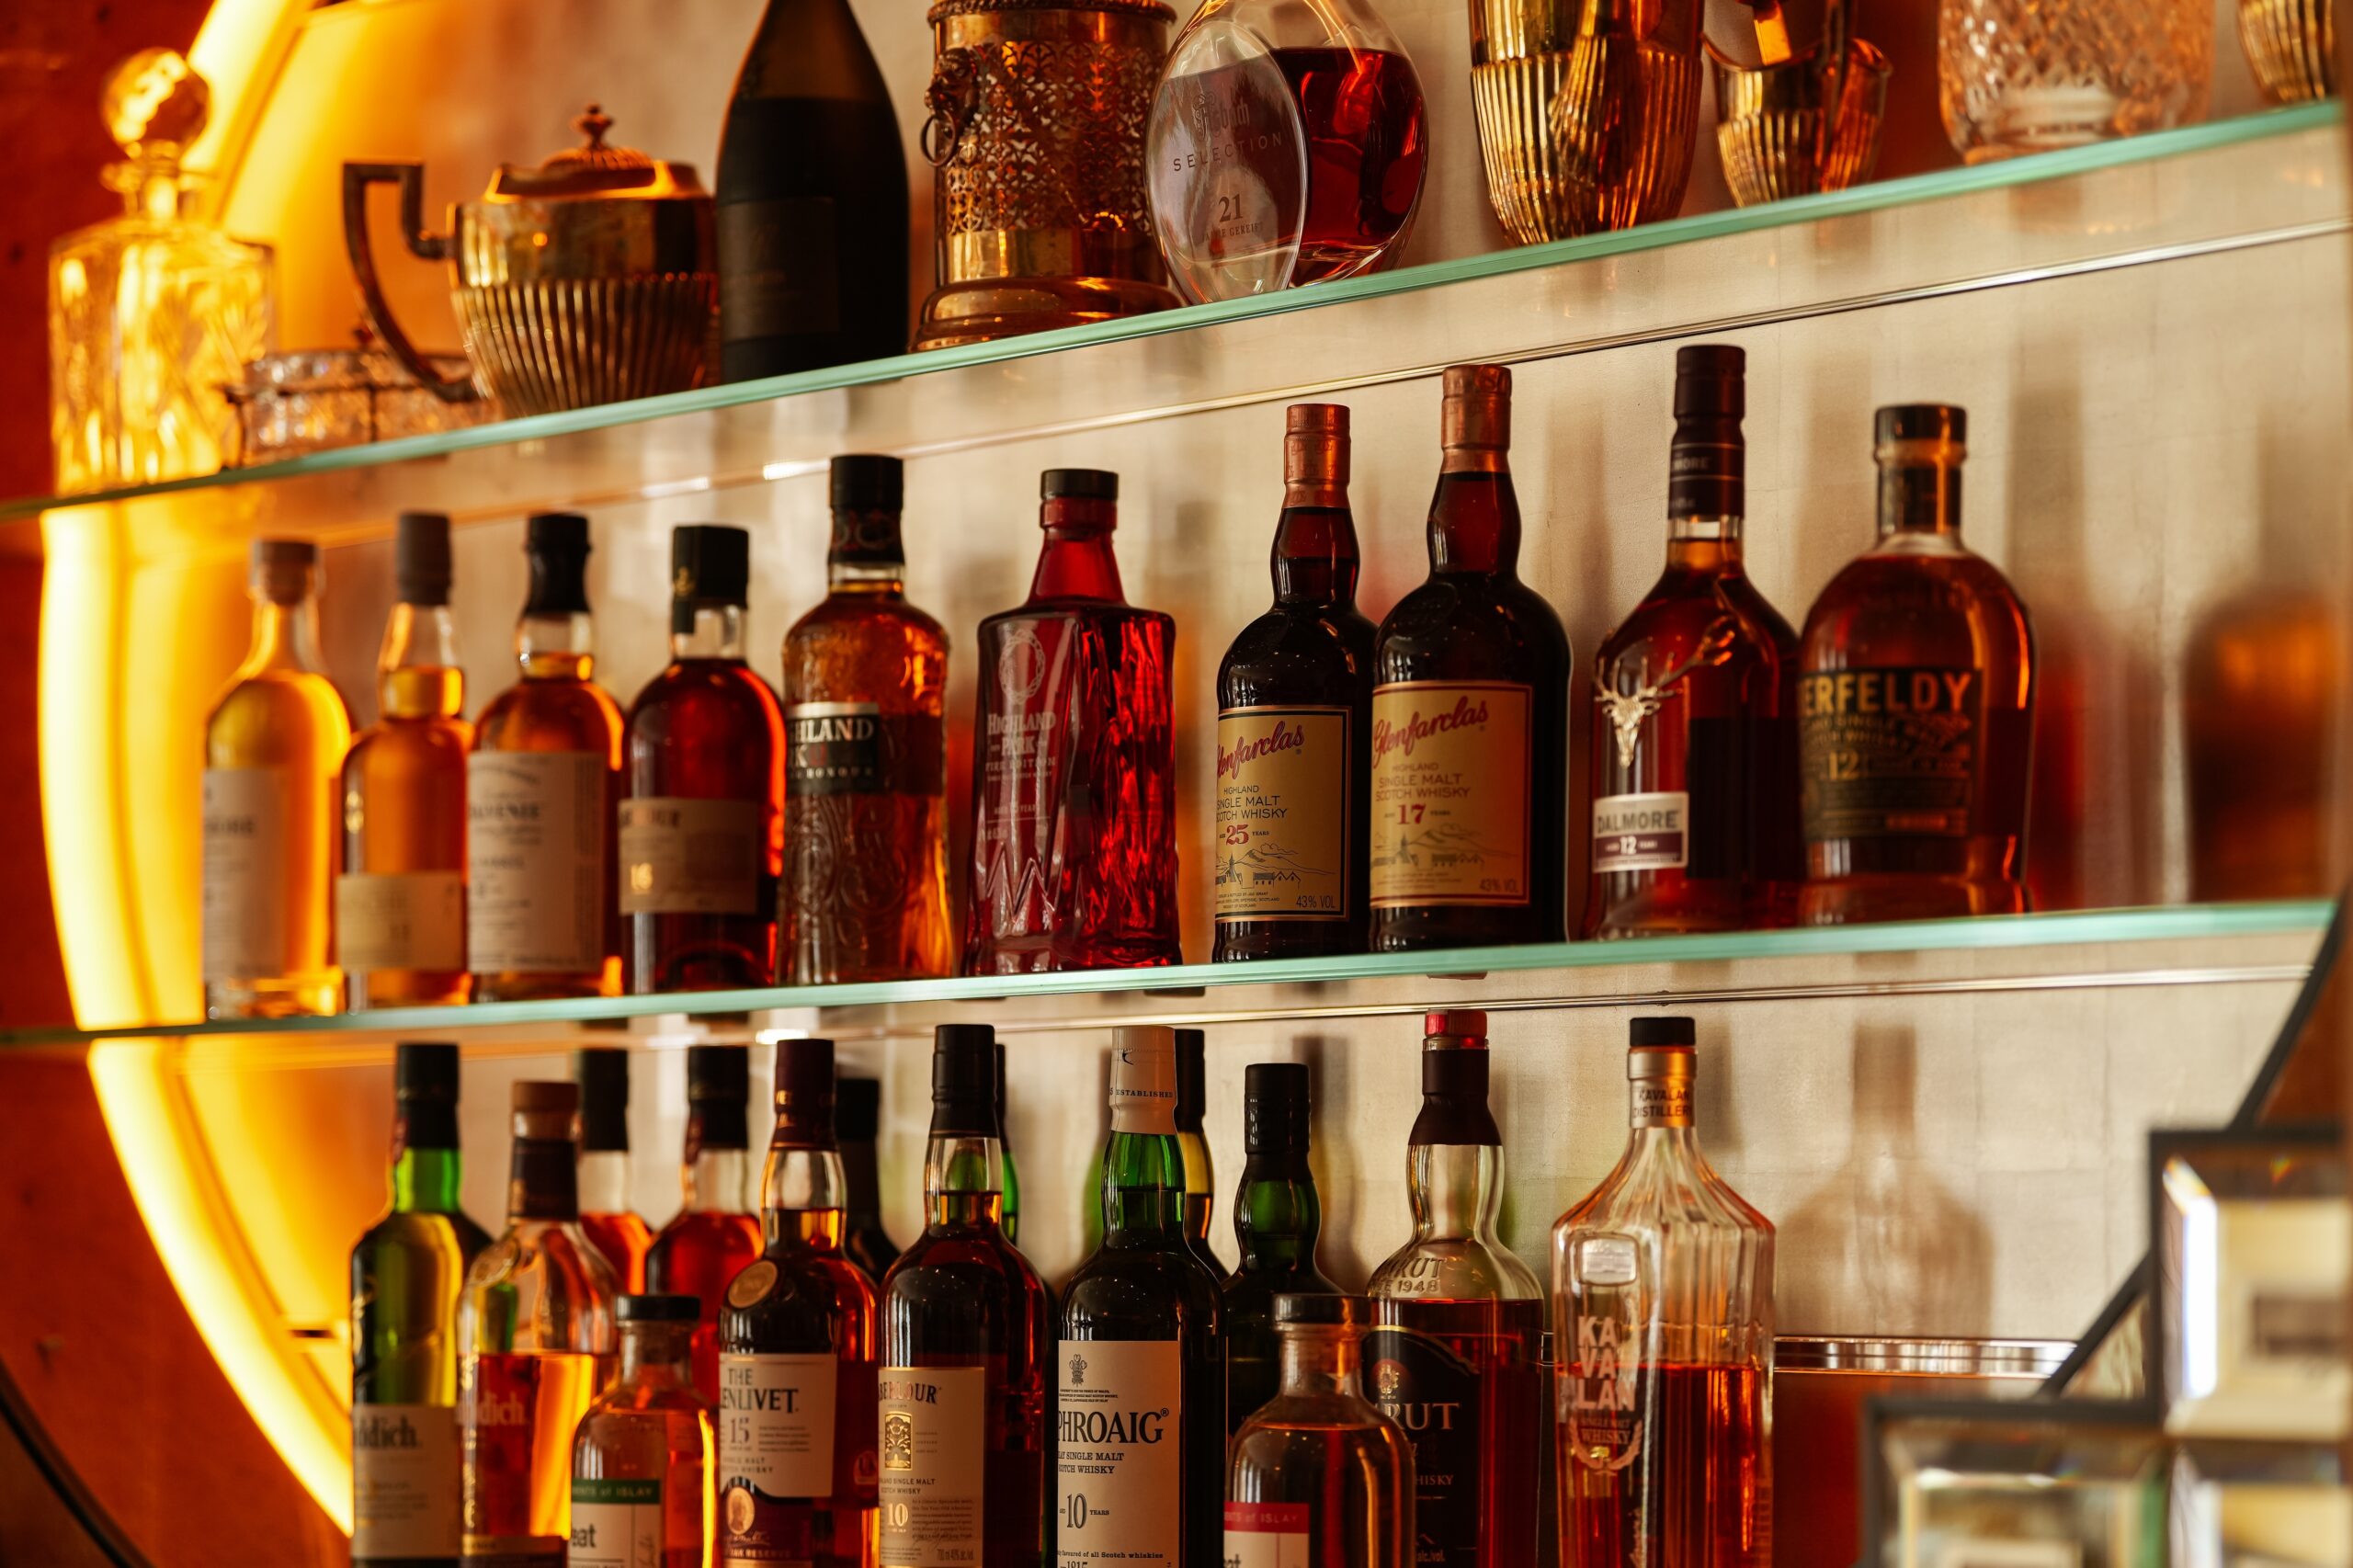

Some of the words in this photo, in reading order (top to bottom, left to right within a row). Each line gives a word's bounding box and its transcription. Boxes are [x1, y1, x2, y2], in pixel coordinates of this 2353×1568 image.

[1173, 131, 1281, 172] SELECTION
[1218, 194, 1243, 222] 21
[988, 711, 1057, 736] HIGHLAND
[1372, 695, 1489, 770] Glenfarclas
[1002, 734, 1036, 756] PARK
[1828, 749, 1859, 781] 12
[1223, 785, 1259, 795] HIGHLAND
[1379, 774, 1417, 789] SINGLE
[1422, 773, 1462, 786] MALT
[1245, 795, 1281, 806] MALT
[1416, 786, 1471, 799] WHISKY
[1241, 808, 1287, 820] WHISKY
[1397, 803, 1427, 825] 17
[1597, 810, 1679, 835] DALMORE
[1225, 824, 1249, 846] 25
[1619, 835, 1637, 856] 12
[1295, 895, 1317, 909] 43%
[1116, 1089, 1174, 1098] ESTABLISHED
[1639, 1088, 1689, 1102] KAVALAN
[1397, 1279, 1438, 1293] 1948
[1578, 1315, 1617, 1347] KA
[1578, 1347, 1617, 1379] VA
[729, 1368, 752, 1386] THE
[1577, 1379, 1636, 1412] LAN
[730, 1416, 751, 1446] 15
[1581, 1428, 1631, 1445] WHISKY
[1066, 1451, 1093, 1460] SINGLE
[1096, 1452, 1125, 1461] MALT
[1077, 1465, 1116, 1474] WHISKY
[897, 1487, 921, 1495] WHISKY
[915, 1478, 936, 1486] MALT
[887, 1503, 909, 1528] 10
[1066, 1493, 1087, 1529] 10
[1260, 1513, 1299, 1524] ISLAY
